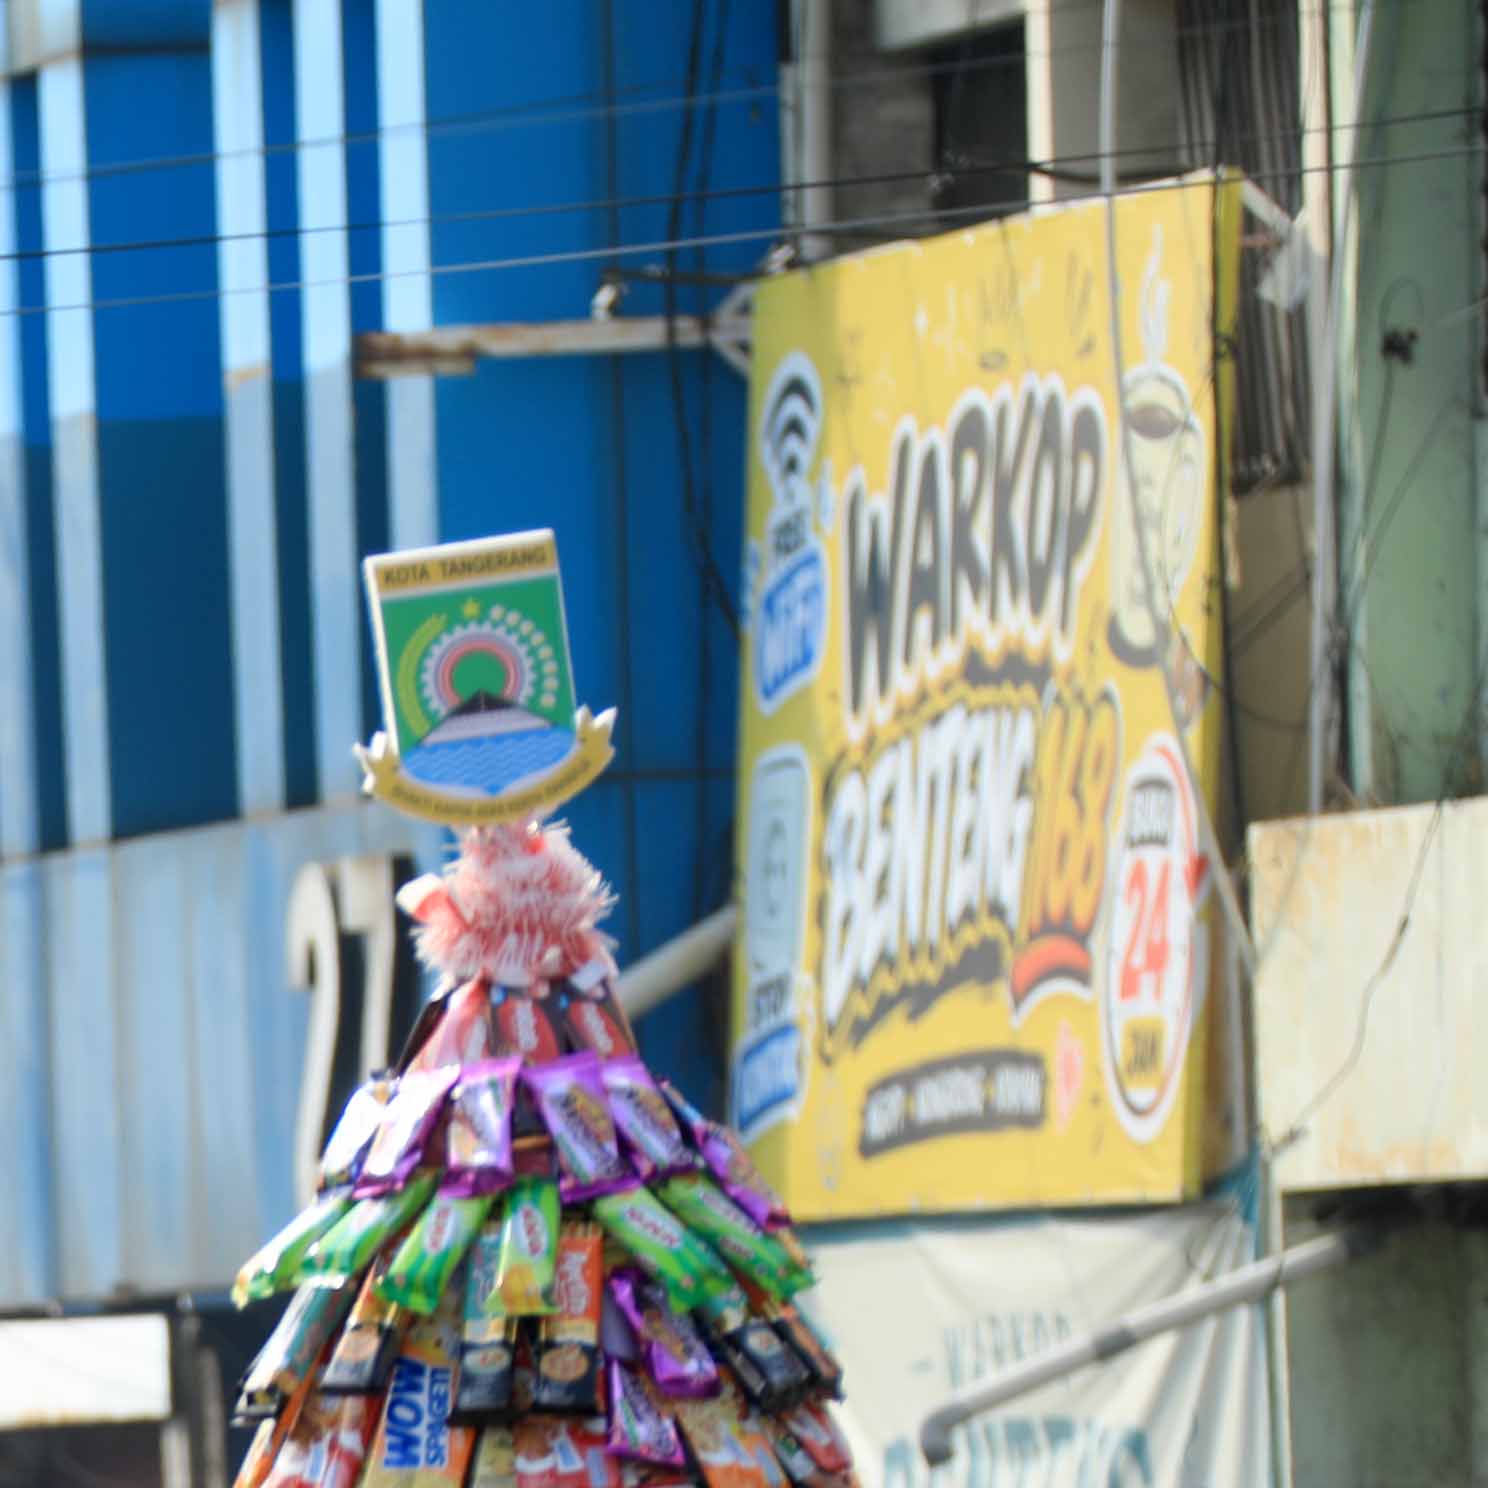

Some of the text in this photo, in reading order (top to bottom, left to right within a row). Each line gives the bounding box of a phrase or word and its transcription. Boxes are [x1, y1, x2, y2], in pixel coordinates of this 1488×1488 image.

[384, 545, 550, 585] KOTA TANGERANG
[848, 392, 1100, 716] WARKOP
[823, 690, 1116, 1026] BENTENG 168
[1120, 857, 1170, 1000] 24
